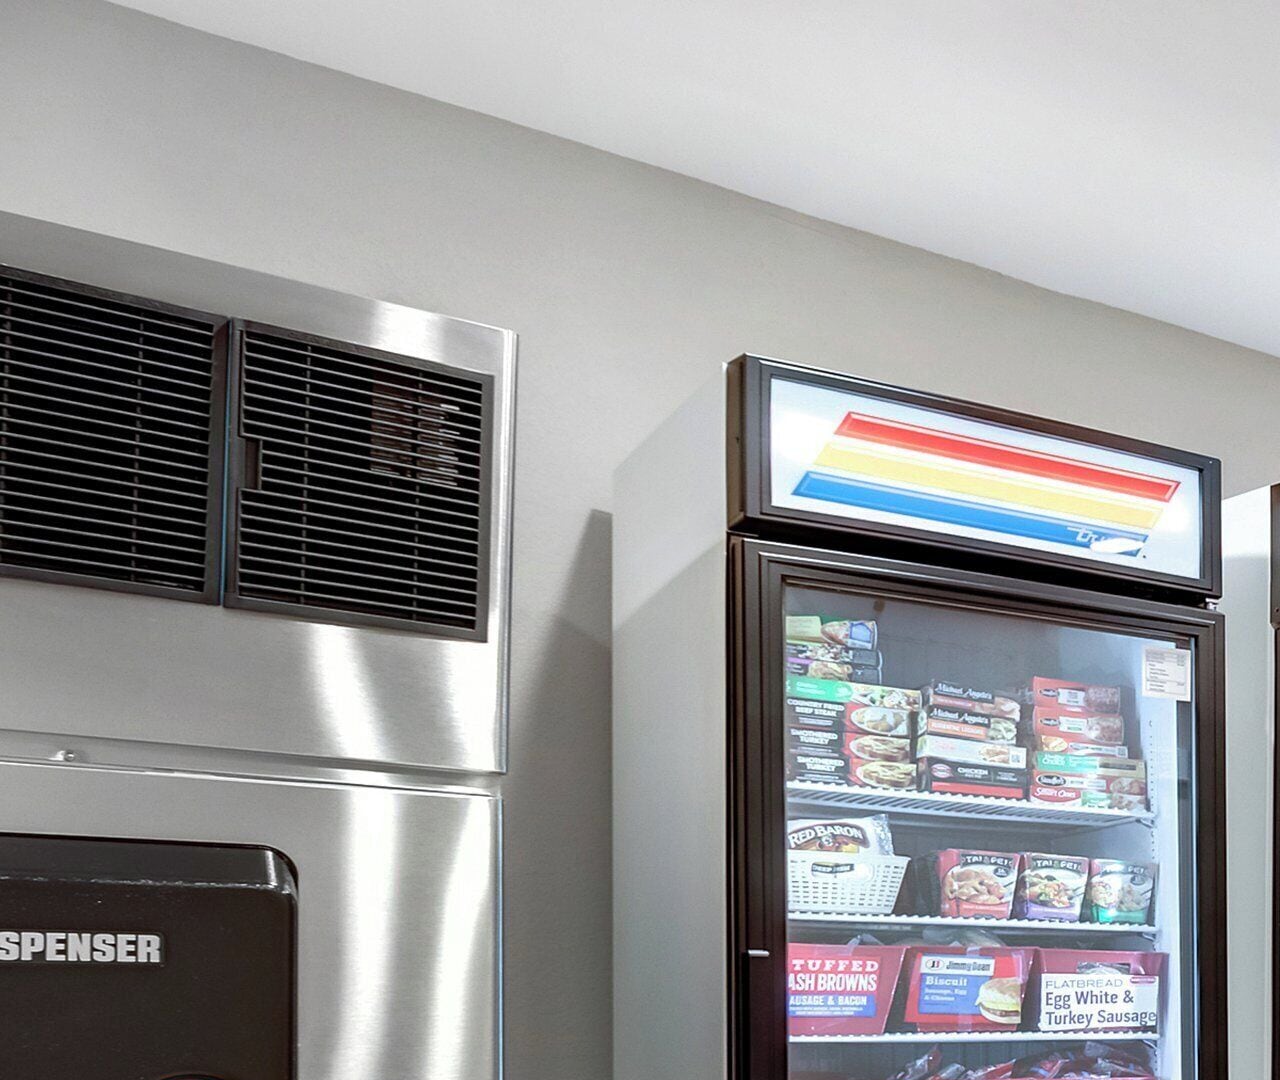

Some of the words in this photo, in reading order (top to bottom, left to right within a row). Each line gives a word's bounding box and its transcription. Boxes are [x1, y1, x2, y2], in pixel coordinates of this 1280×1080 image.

[788, 829, 815, 848] RED
[815, 825, 863, 839] BARON
[965, 855, 983, 865] TAI
[990, 856, 1008, 866] PEI
[0, 932, 162, 963] SPENSER
[792, 959, 880, 972] TUFFED
[788, 973, 816, 991] ASH
[817, 973, 877, 992] BROWNS
[925, 975, 968, 987] Biscuit
[1045, 979, 1124, 989] FLATBREAD
[838, 995, 867, 1006] BACON
[1045, 992, 1071, 1009] Egg
[1075, 990, 1118, 1005] White
[1123, 990, 1134, 1003] &
[1045, 1011, 1093, 1027] Turkey
[1097, 1010, 1157, 1026] Sausage
